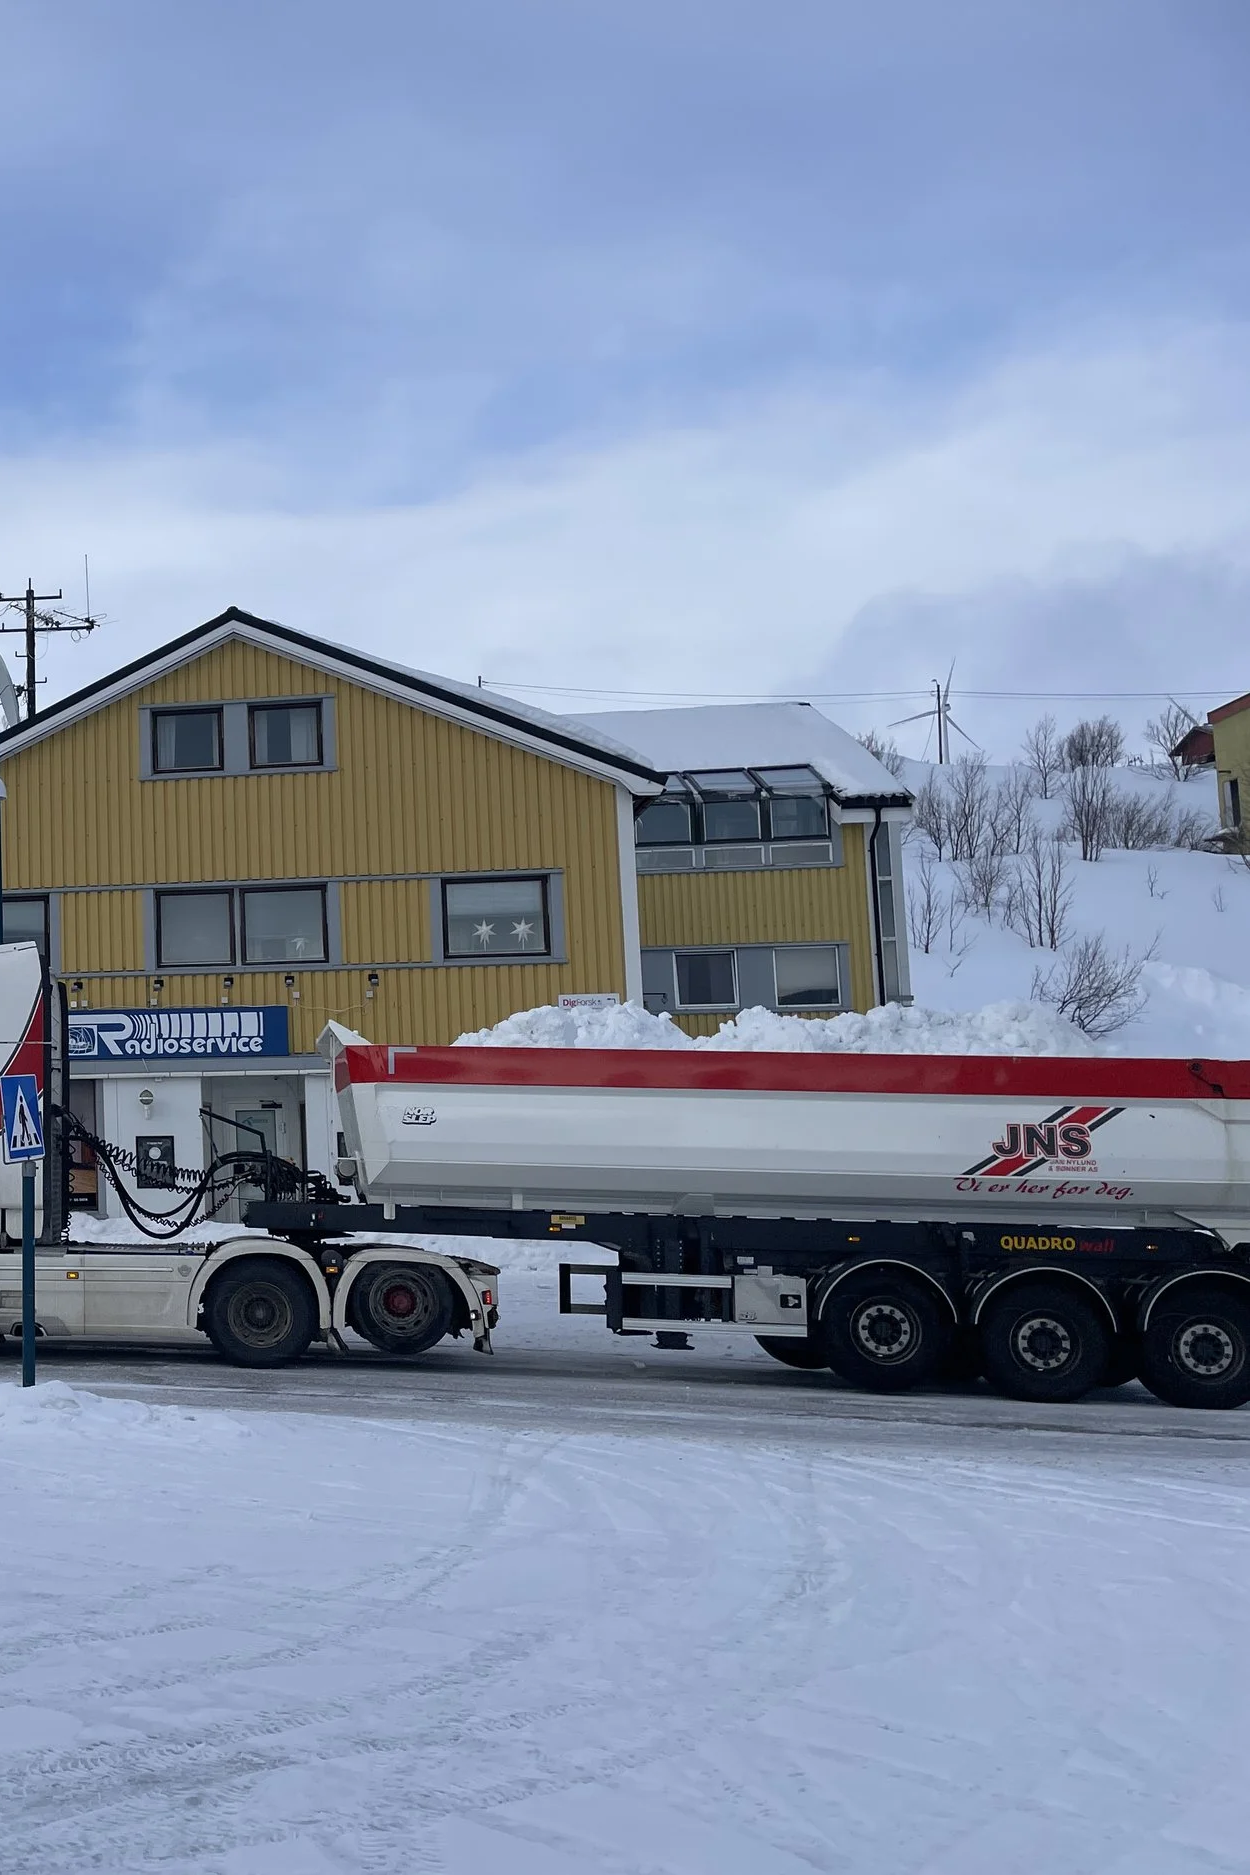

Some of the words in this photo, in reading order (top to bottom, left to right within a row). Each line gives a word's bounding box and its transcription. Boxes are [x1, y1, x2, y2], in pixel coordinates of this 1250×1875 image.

[69, 1013, 264, 1056] Radioservice
[992, 1123, 1092, 1160] JNS
[953, 1177, 981, 1192] Vi
[988, 1182, 1010, 1193] er
[1015, 1179, 1050, 1194] her
[1052, 1180, 1090, 1199] for
[1095, 1181, 1134, 1200] deg.
[1000, 1235, 1076, 1251] QUADRO
